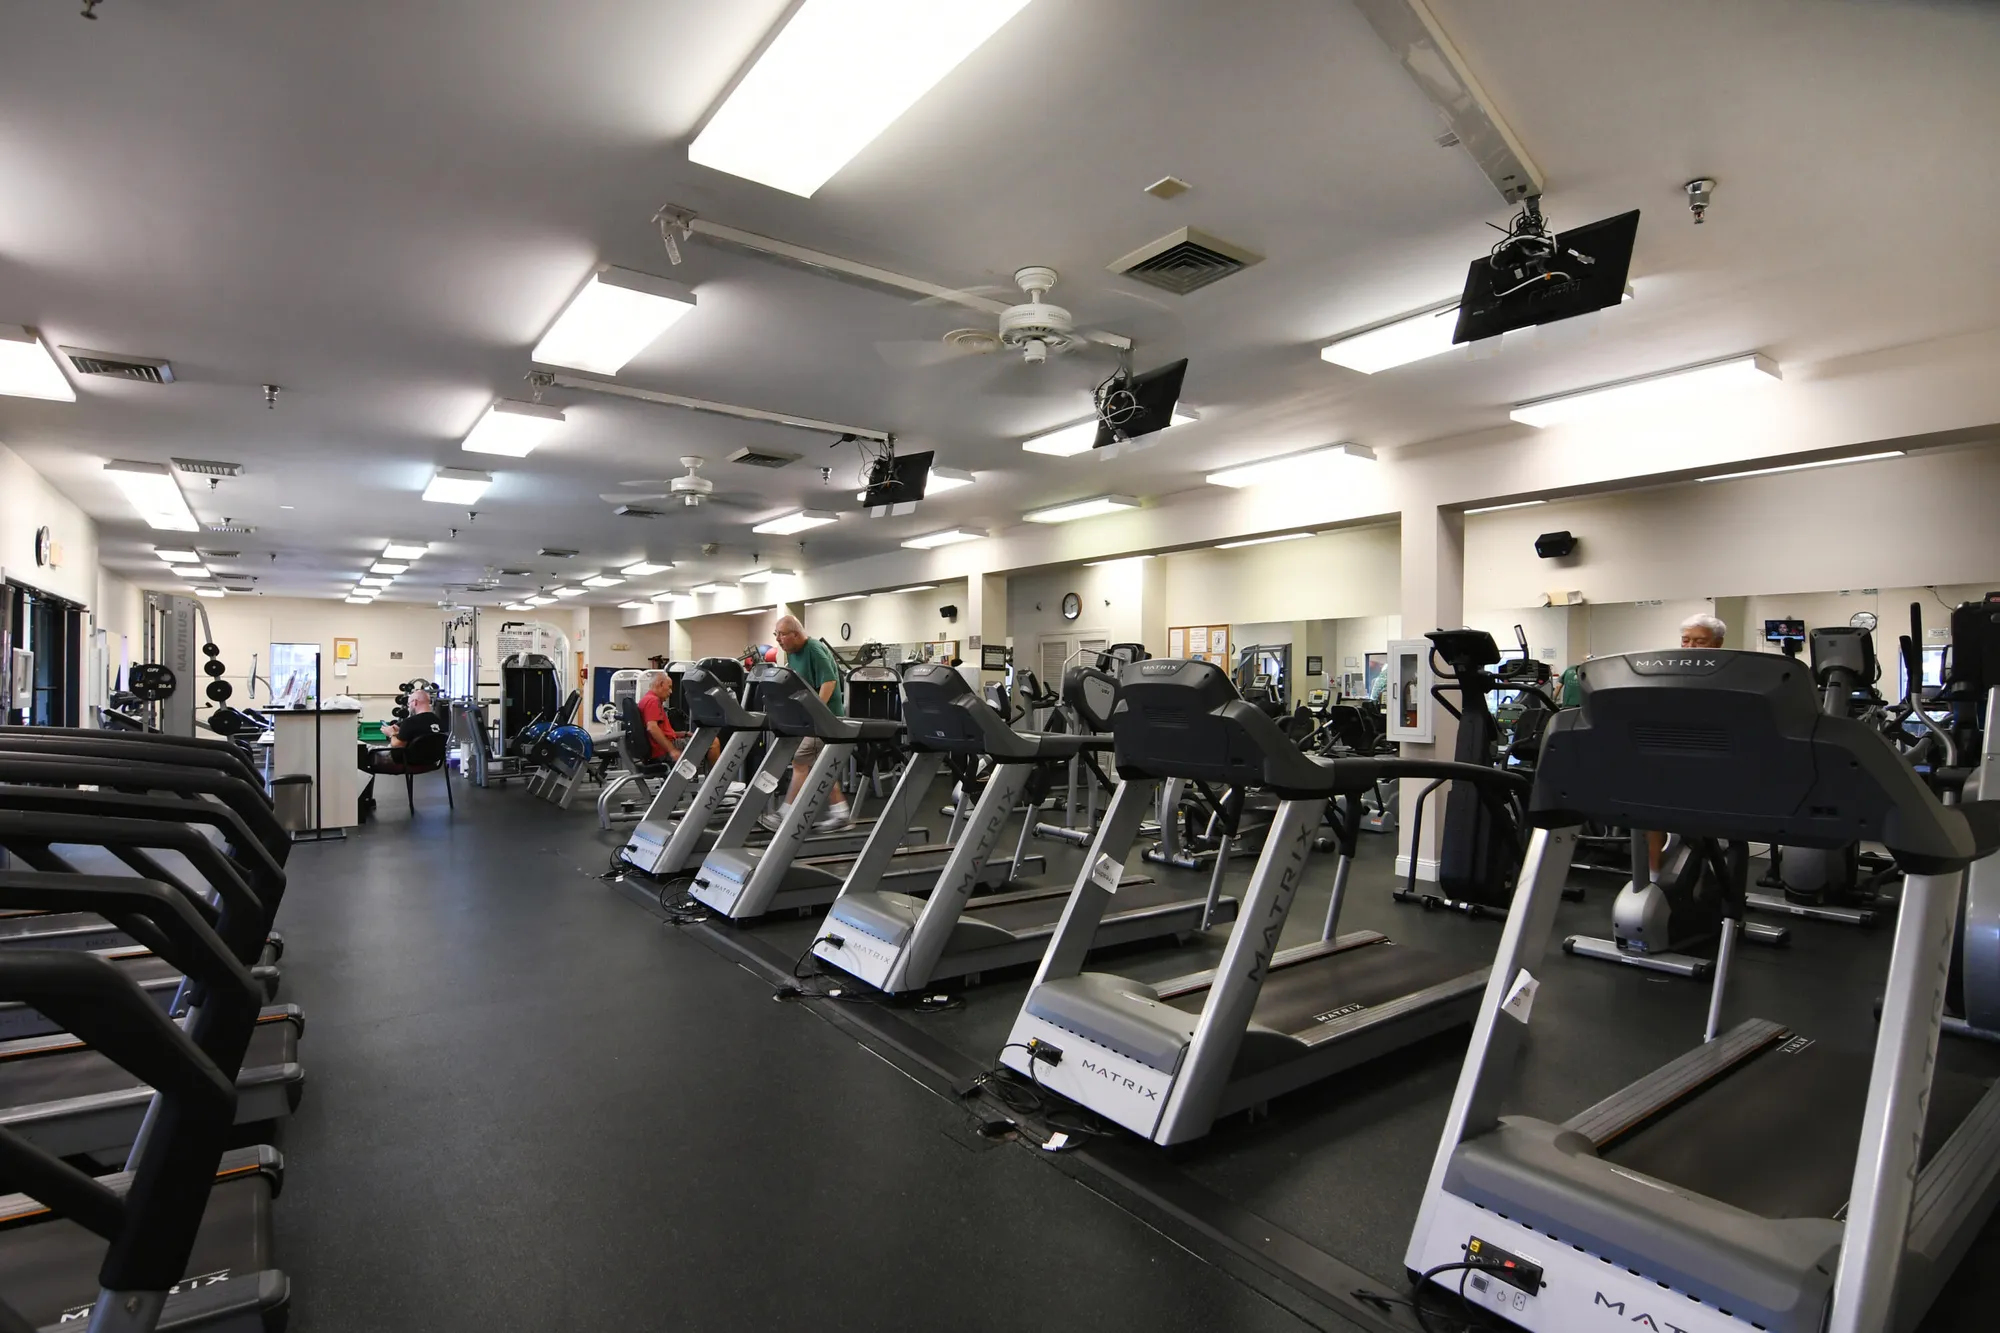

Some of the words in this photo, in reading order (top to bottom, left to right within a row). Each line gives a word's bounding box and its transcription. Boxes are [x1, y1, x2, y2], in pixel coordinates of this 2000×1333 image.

[177, 610, 188, 672] NAUTILUS
[1635, 659, 1716, 667] MATRIX
[704, 741, 748, 811] MATRIX
[791, 757, 842, 841] MATRIX
[957, 786, 1015, 894] MATRIX
[1247, 823, 1312, 982] MATRIX
[853, 943, 892, 965] MATRIX
[1316, 1004, 1364, 1022] MATRIX
[1082, 1059, 1158, 1101] MATRIX
